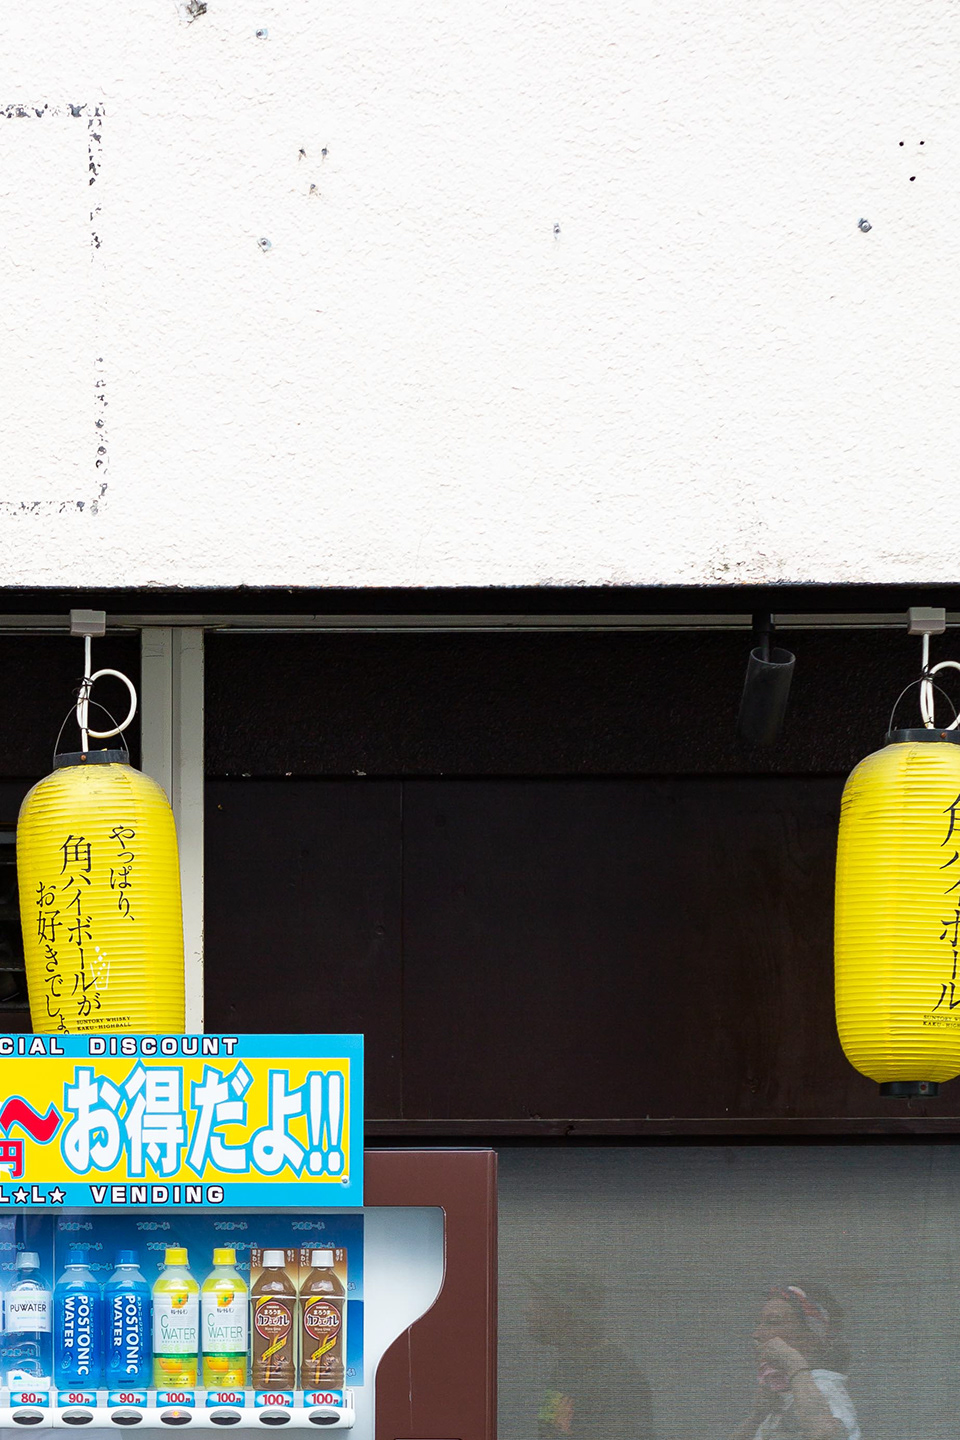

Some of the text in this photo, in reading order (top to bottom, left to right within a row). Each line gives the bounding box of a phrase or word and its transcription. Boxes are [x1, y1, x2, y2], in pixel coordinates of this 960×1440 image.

[108, 825, 136, 921] やっぱり、
[60, 835, 102, 1017] 角ハイボールが
[89, 1036, 239, 1057] DISCOUNT
[90, 1184, 227, 1205] VENDING
[10, 1303, 46, 1312] PUWATER
[64, 1296, 75, 1348] WATER
[114, 1296, 123, 1346] WATER
[160, 1314, 169, 1328] C
[207, 1312, 215, 1327] C
[258, 1314, 290, 1326] カフェオレ
[307, 1314, 339, 1326] カフェオレ
[77, 1295, 90, 1376] POSTONIC
[125, 1294, 139, 1374] POSTONIC
[161, 1327, 196, 1340] WATER
[207, 1326, 243, 1338] WATER
